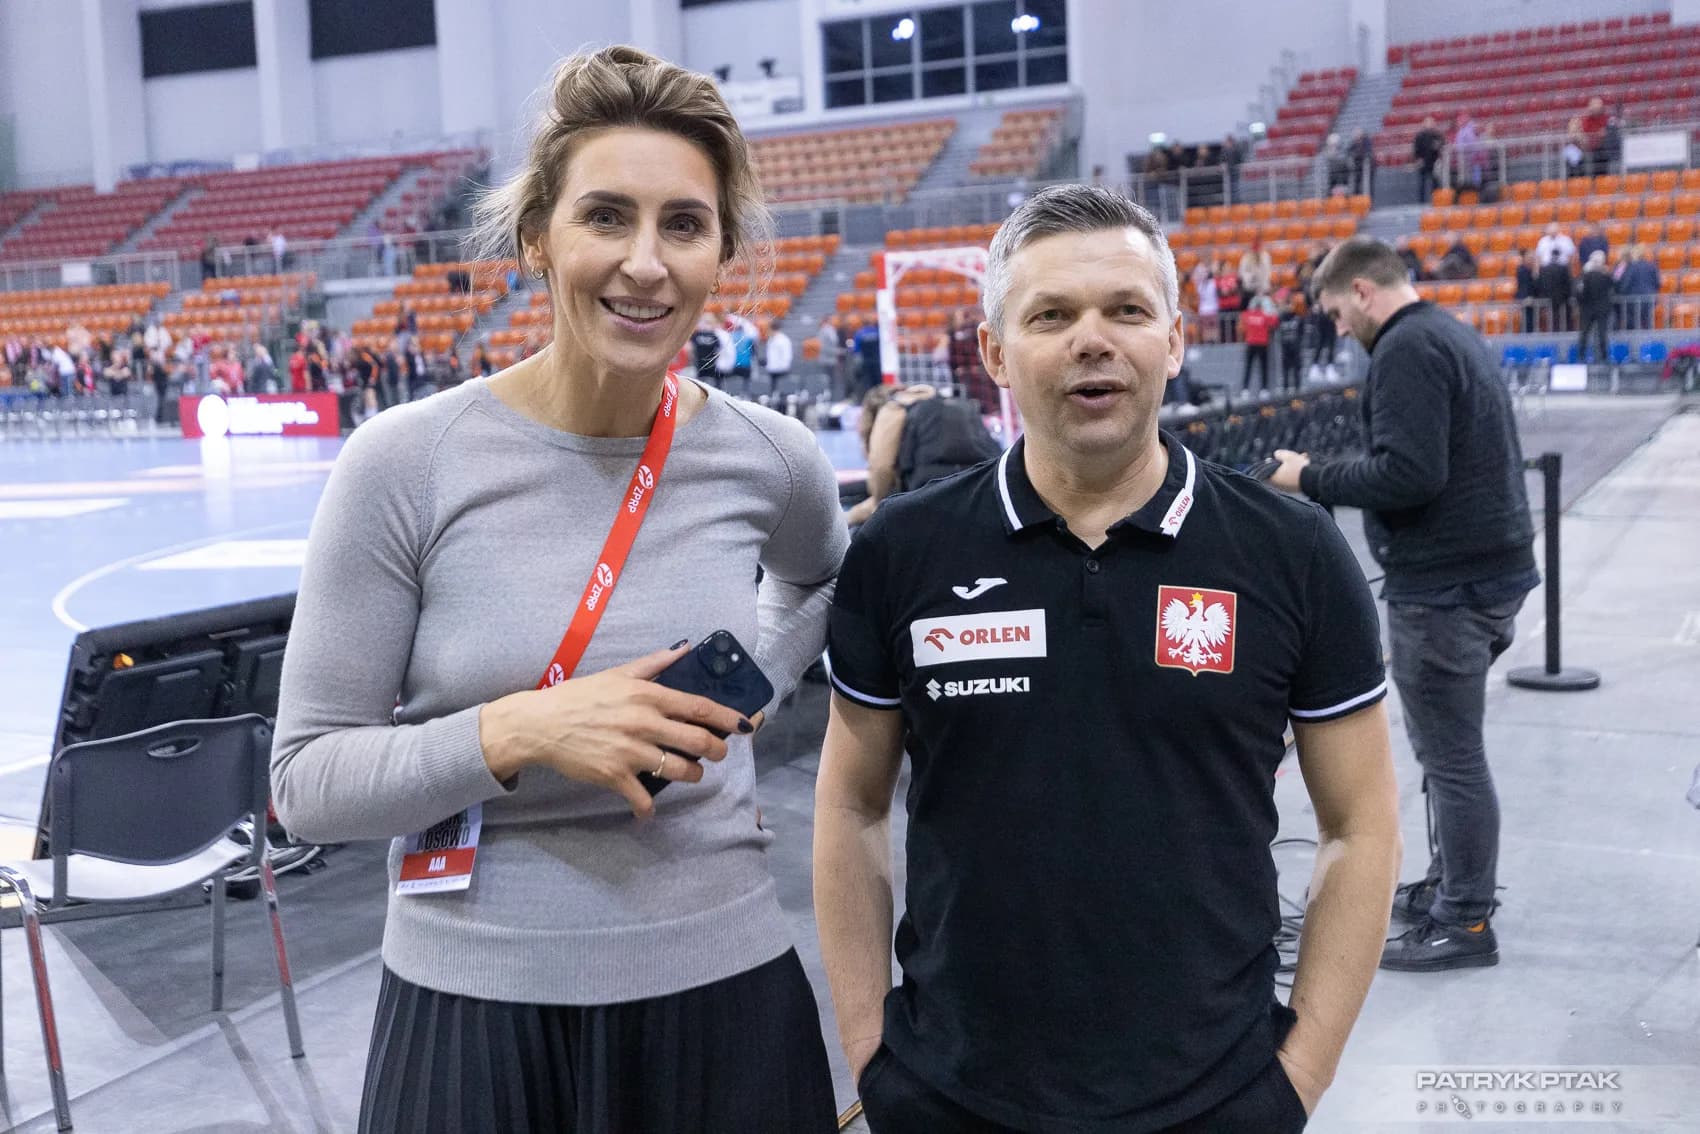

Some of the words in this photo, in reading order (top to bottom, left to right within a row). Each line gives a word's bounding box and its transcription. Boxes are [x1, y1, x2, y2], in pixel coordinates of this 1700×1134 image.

[627, 485, 645, 513] ZPRP
[1175, 495, 1191, 518] ORLEN
[585, 583, 604, 611] ZPRP
[959, 625, 1031, 646] ORLEN
[944, 676, 1030, 697] SUZUKI
[416, 825, 471, 851] KOSOWO
